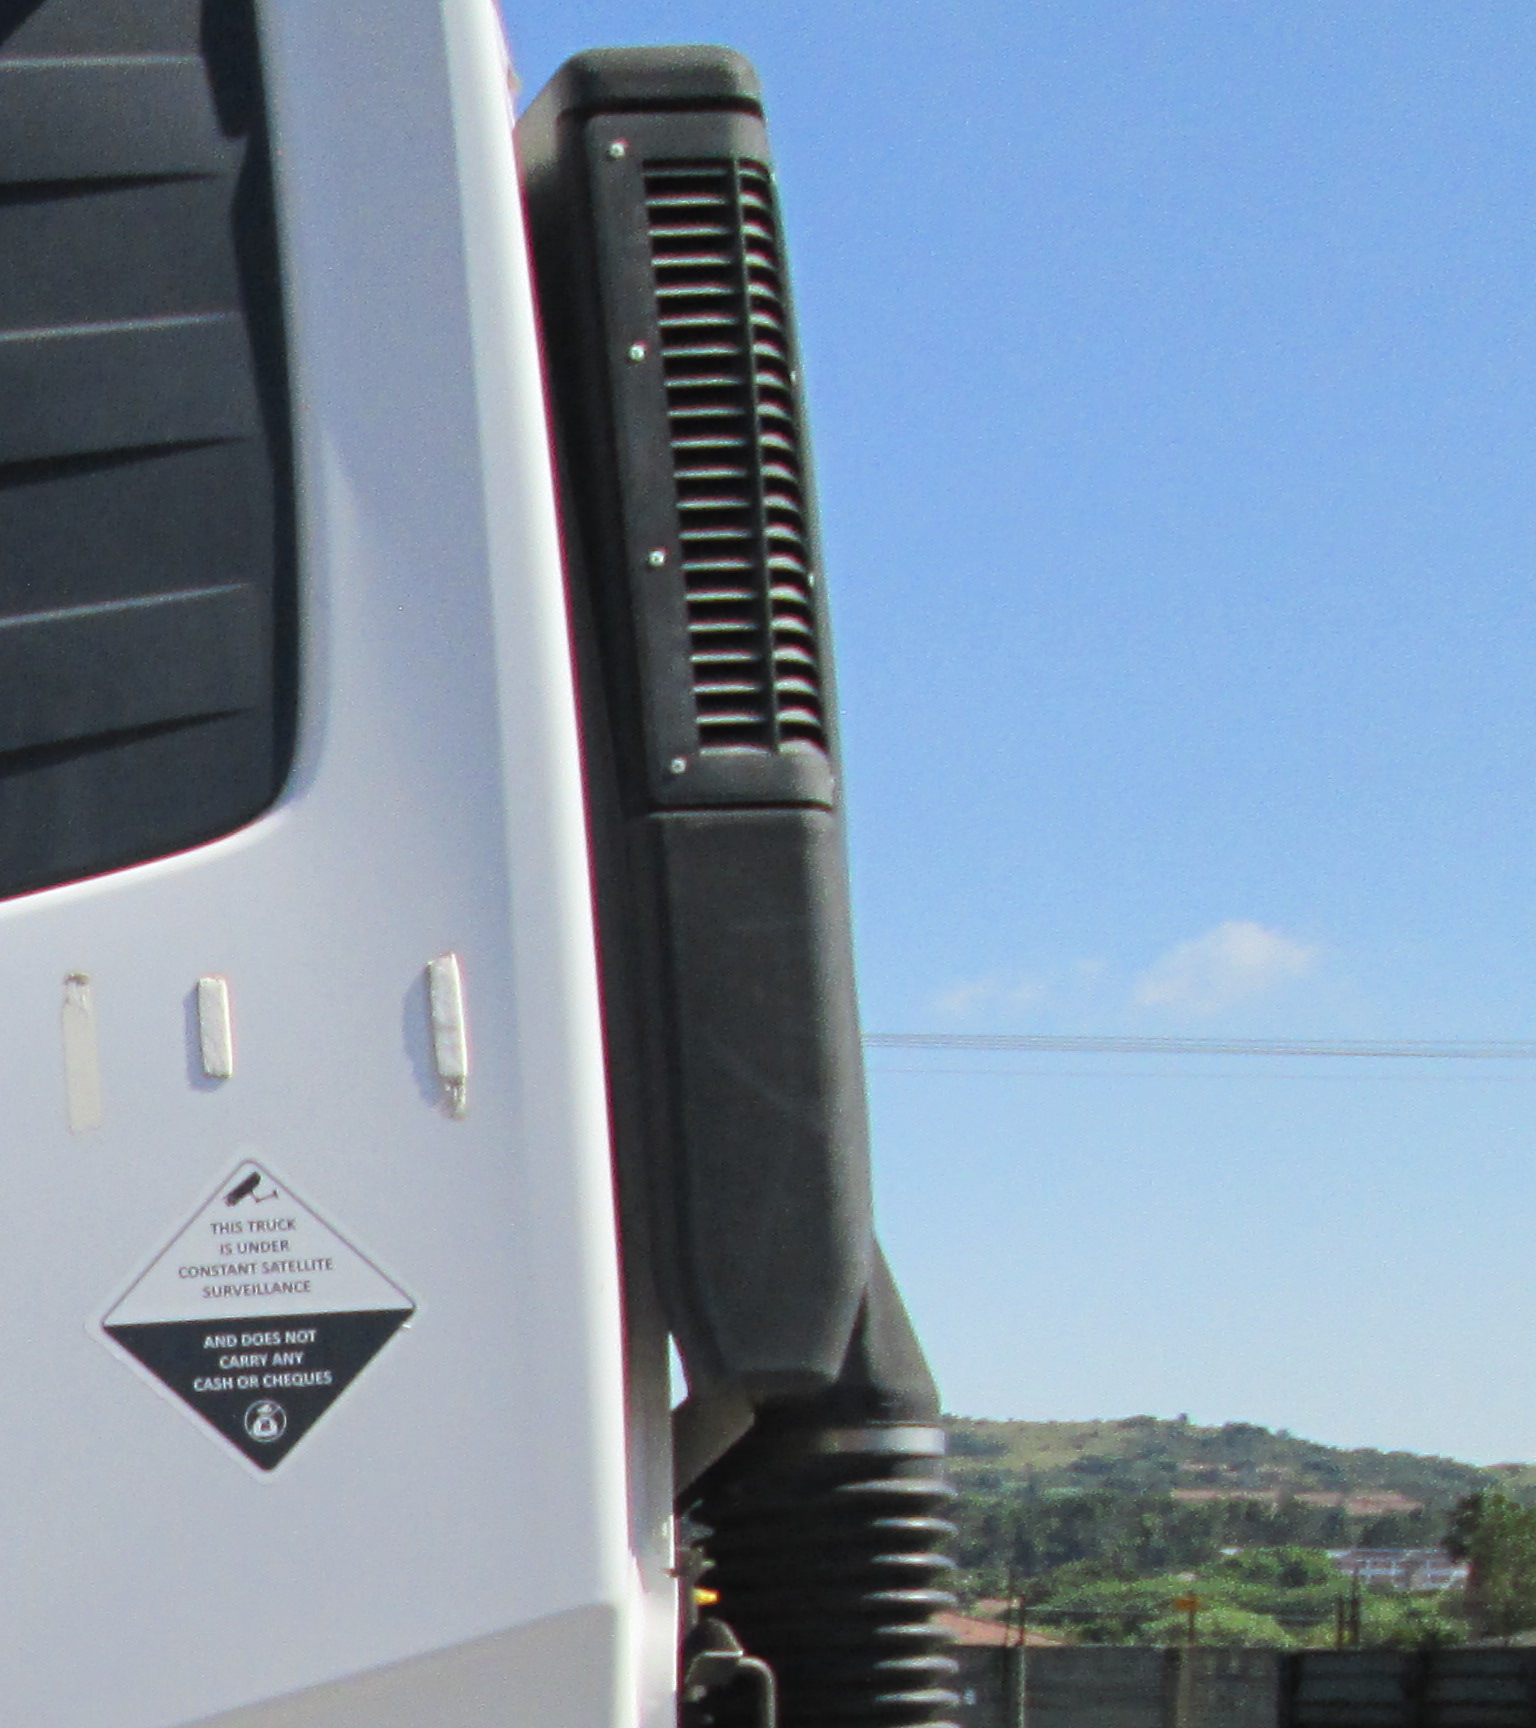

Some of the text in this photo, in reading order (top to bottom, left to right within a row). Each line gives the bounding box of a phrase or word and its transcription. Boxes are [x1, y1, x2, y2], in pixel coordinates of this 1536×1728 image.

[210, 1219, 296, 1234] THIS TRUCK
[220, 1240, 289, 1255] IS UNDER
[179, 1259, 333, 1279] CONSTANT SATELLITE
[202, 1281, 311, 1298] SURVEILLANCE
[204, 1330, 316, 1349] AND DOES NOT
[219, 1352, 304, 1368] CARRY ANY
[194, 1372, 332, 1391] CASH OR CHEQUES
